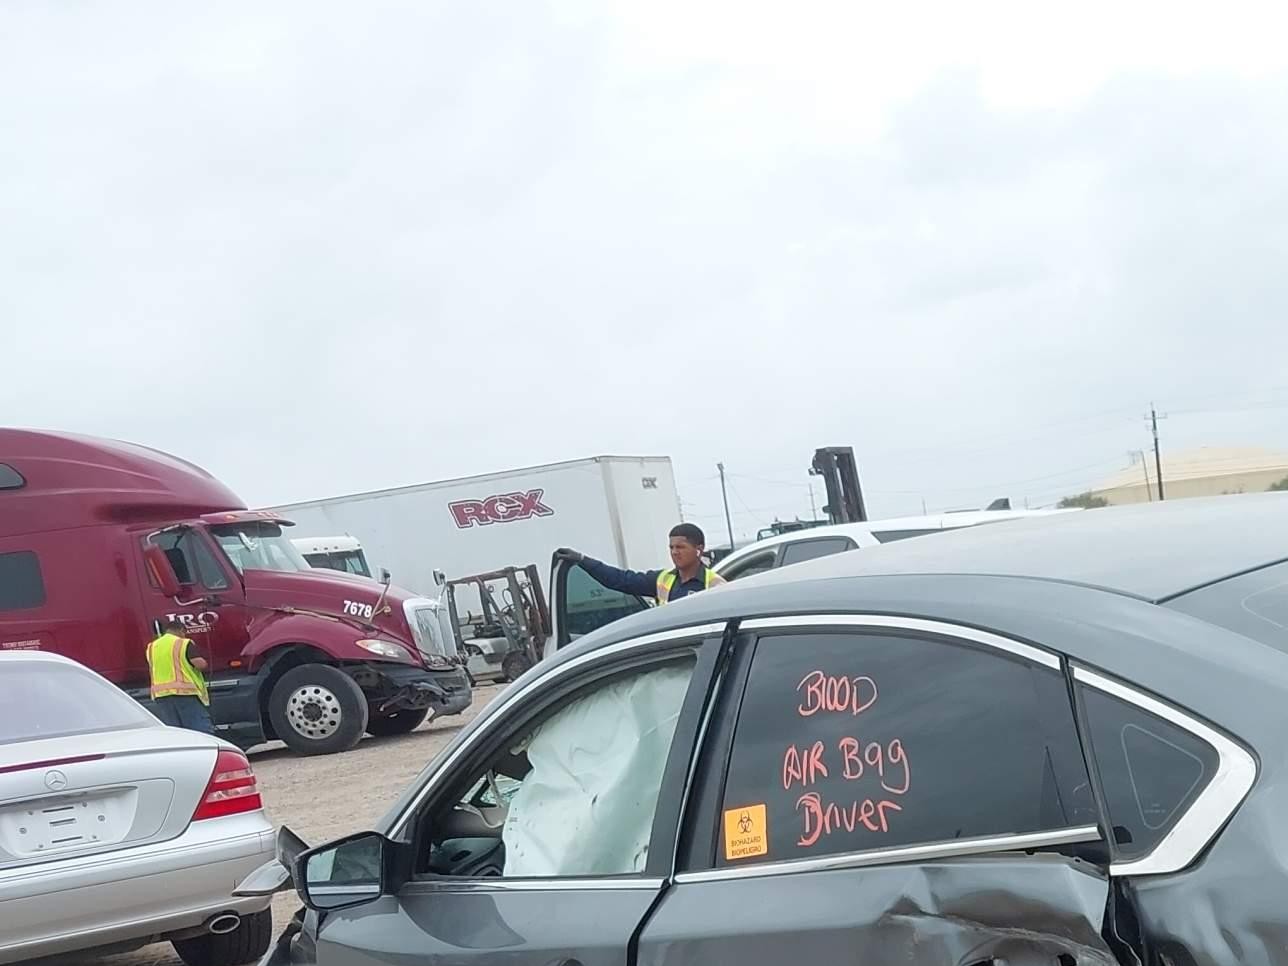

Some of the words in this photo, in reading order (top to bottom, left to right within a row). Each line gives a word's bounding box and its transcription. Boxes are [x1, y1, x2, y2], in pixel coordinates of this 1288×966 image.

[448, 490, 554, 529] RCX
[343, 600, 372, 618] 7678
[783, 740, 828, 790] AIR
[795, 792, 902, 846] Driver
